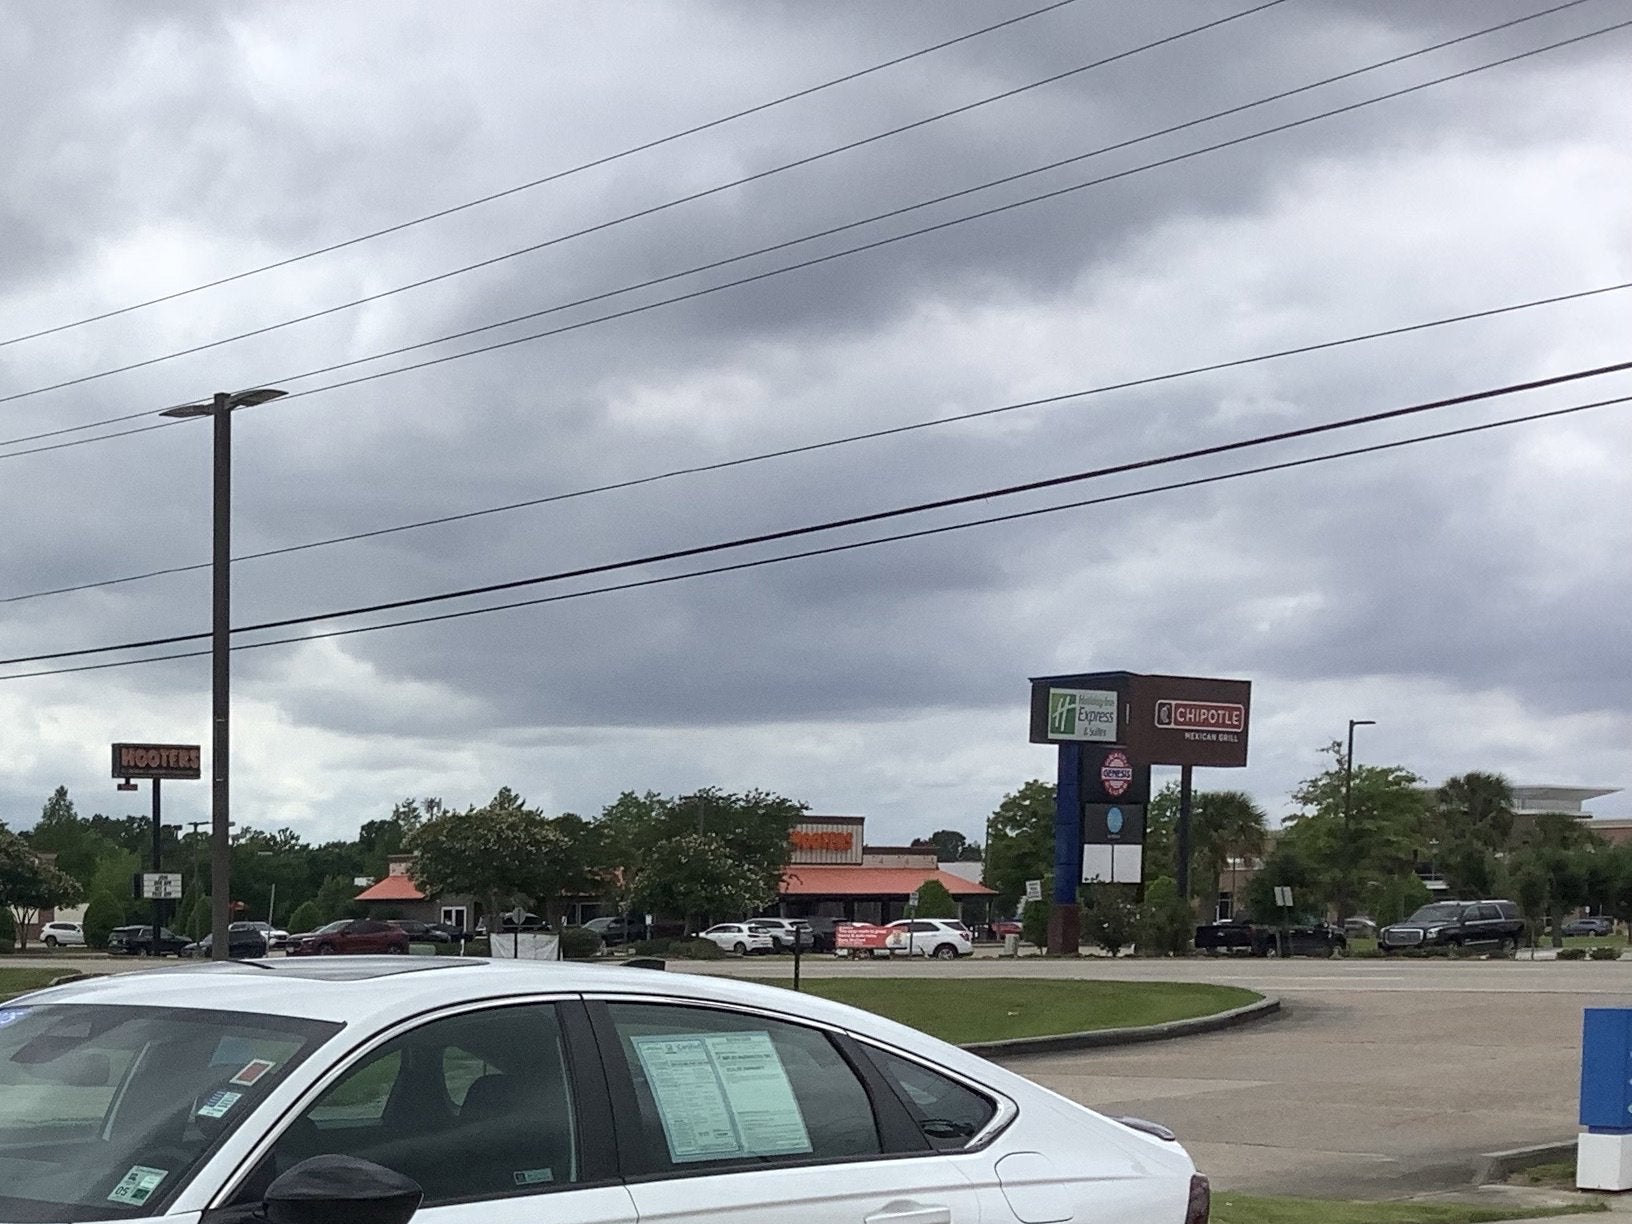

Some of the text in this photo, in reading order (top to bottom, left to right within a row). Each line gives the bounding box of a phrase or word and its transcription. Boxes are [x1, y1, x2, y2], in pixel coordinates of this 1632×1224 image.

[1078, 706, 1114, 725] Express
[1176, 707, 1240, 725] CHIPOTLE
[1184, 732, 1239, 742] MEXICAN GRILL
[121, 748, 199, 768] HOOTERS
[1103, 768, 1131, 778] GENESIS
